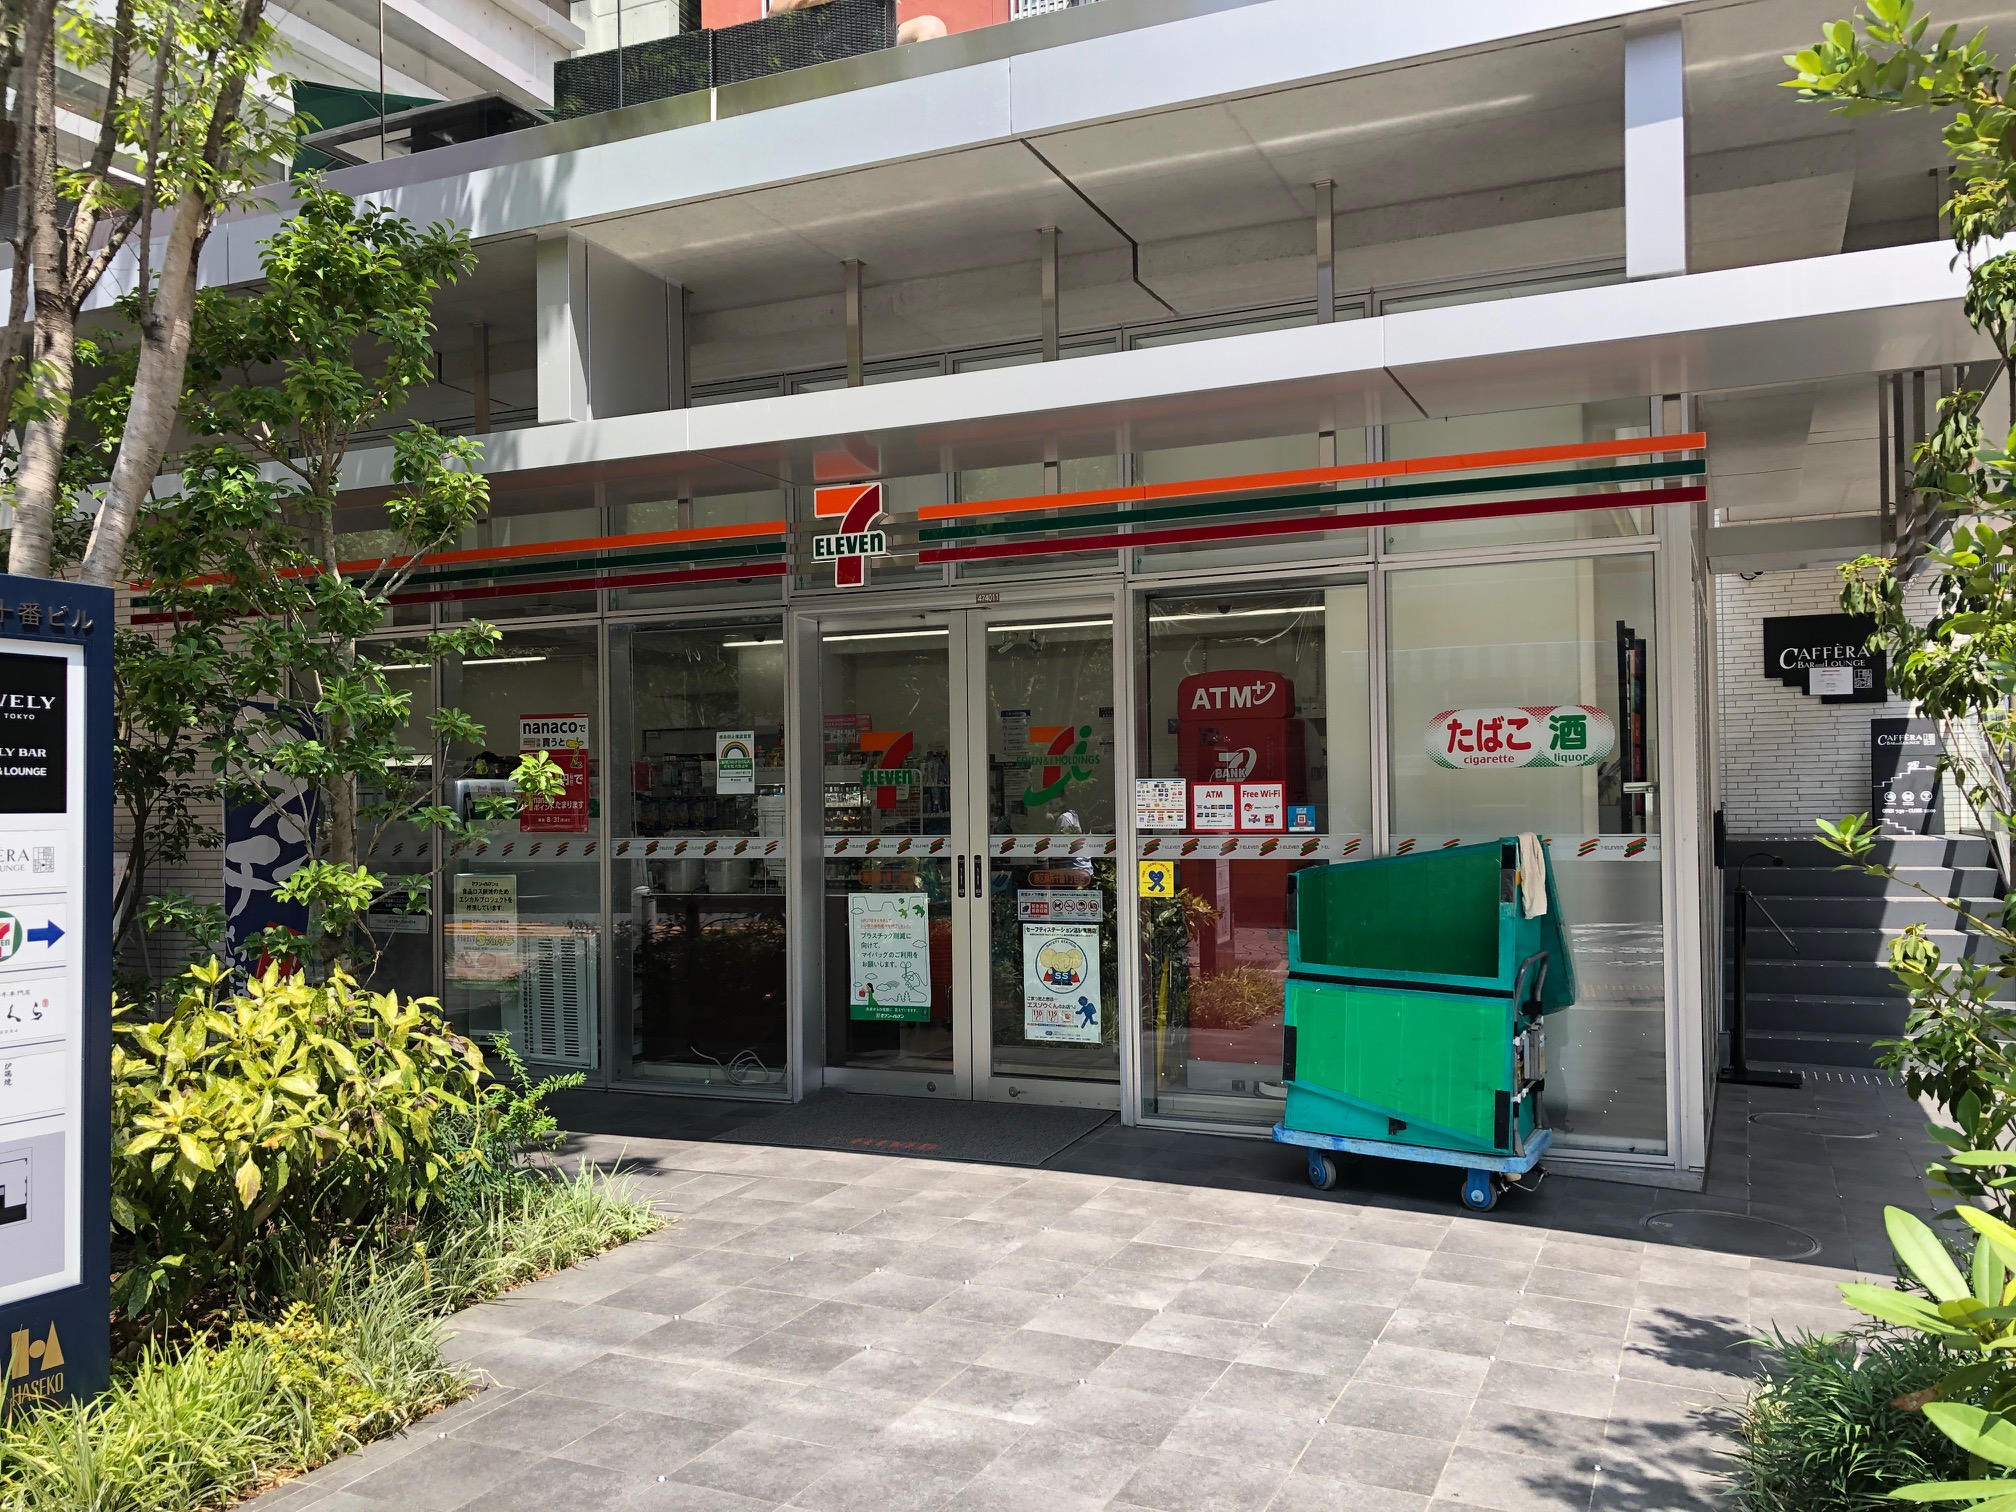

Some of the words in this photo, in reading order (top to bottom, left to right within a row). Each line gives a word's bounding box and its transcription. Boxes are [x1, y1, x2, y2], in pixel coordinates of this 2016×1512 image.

[4, 712, 35, 720] TOKYO
[1446, 715, 1532, 754] たばこ
[1549, 714, 1587, 751] 酒
[542, 737, 565, 748] 買うと
[18, 748, 47, 757] BAR
[1055, 755, 1100, 765] HOLDINGS
[1463, 754, 1515, 766] cigarette
[1553, 752, 1589, 764] liquor
[1907, 760, 1920, 768] 2F
[4, 766, 47, 776] LOUNGE
[1214, 768, 1249, 780] BANK
[1205, 790, 1223, 798] ATM
[1242, 790, 1258, 798] Free
[1260, 789, 1281, 798] Wi-Fi
[459, 896, 513, 904] エシカルプロジェクトを
[861, 932, 912, 940] プラスチック削減に
[861, 951, 918, 959] マイバッグのご利用を
[1054, 972, 1069, 980] SS
[11, 1371, 64, 1407] HASEKO
